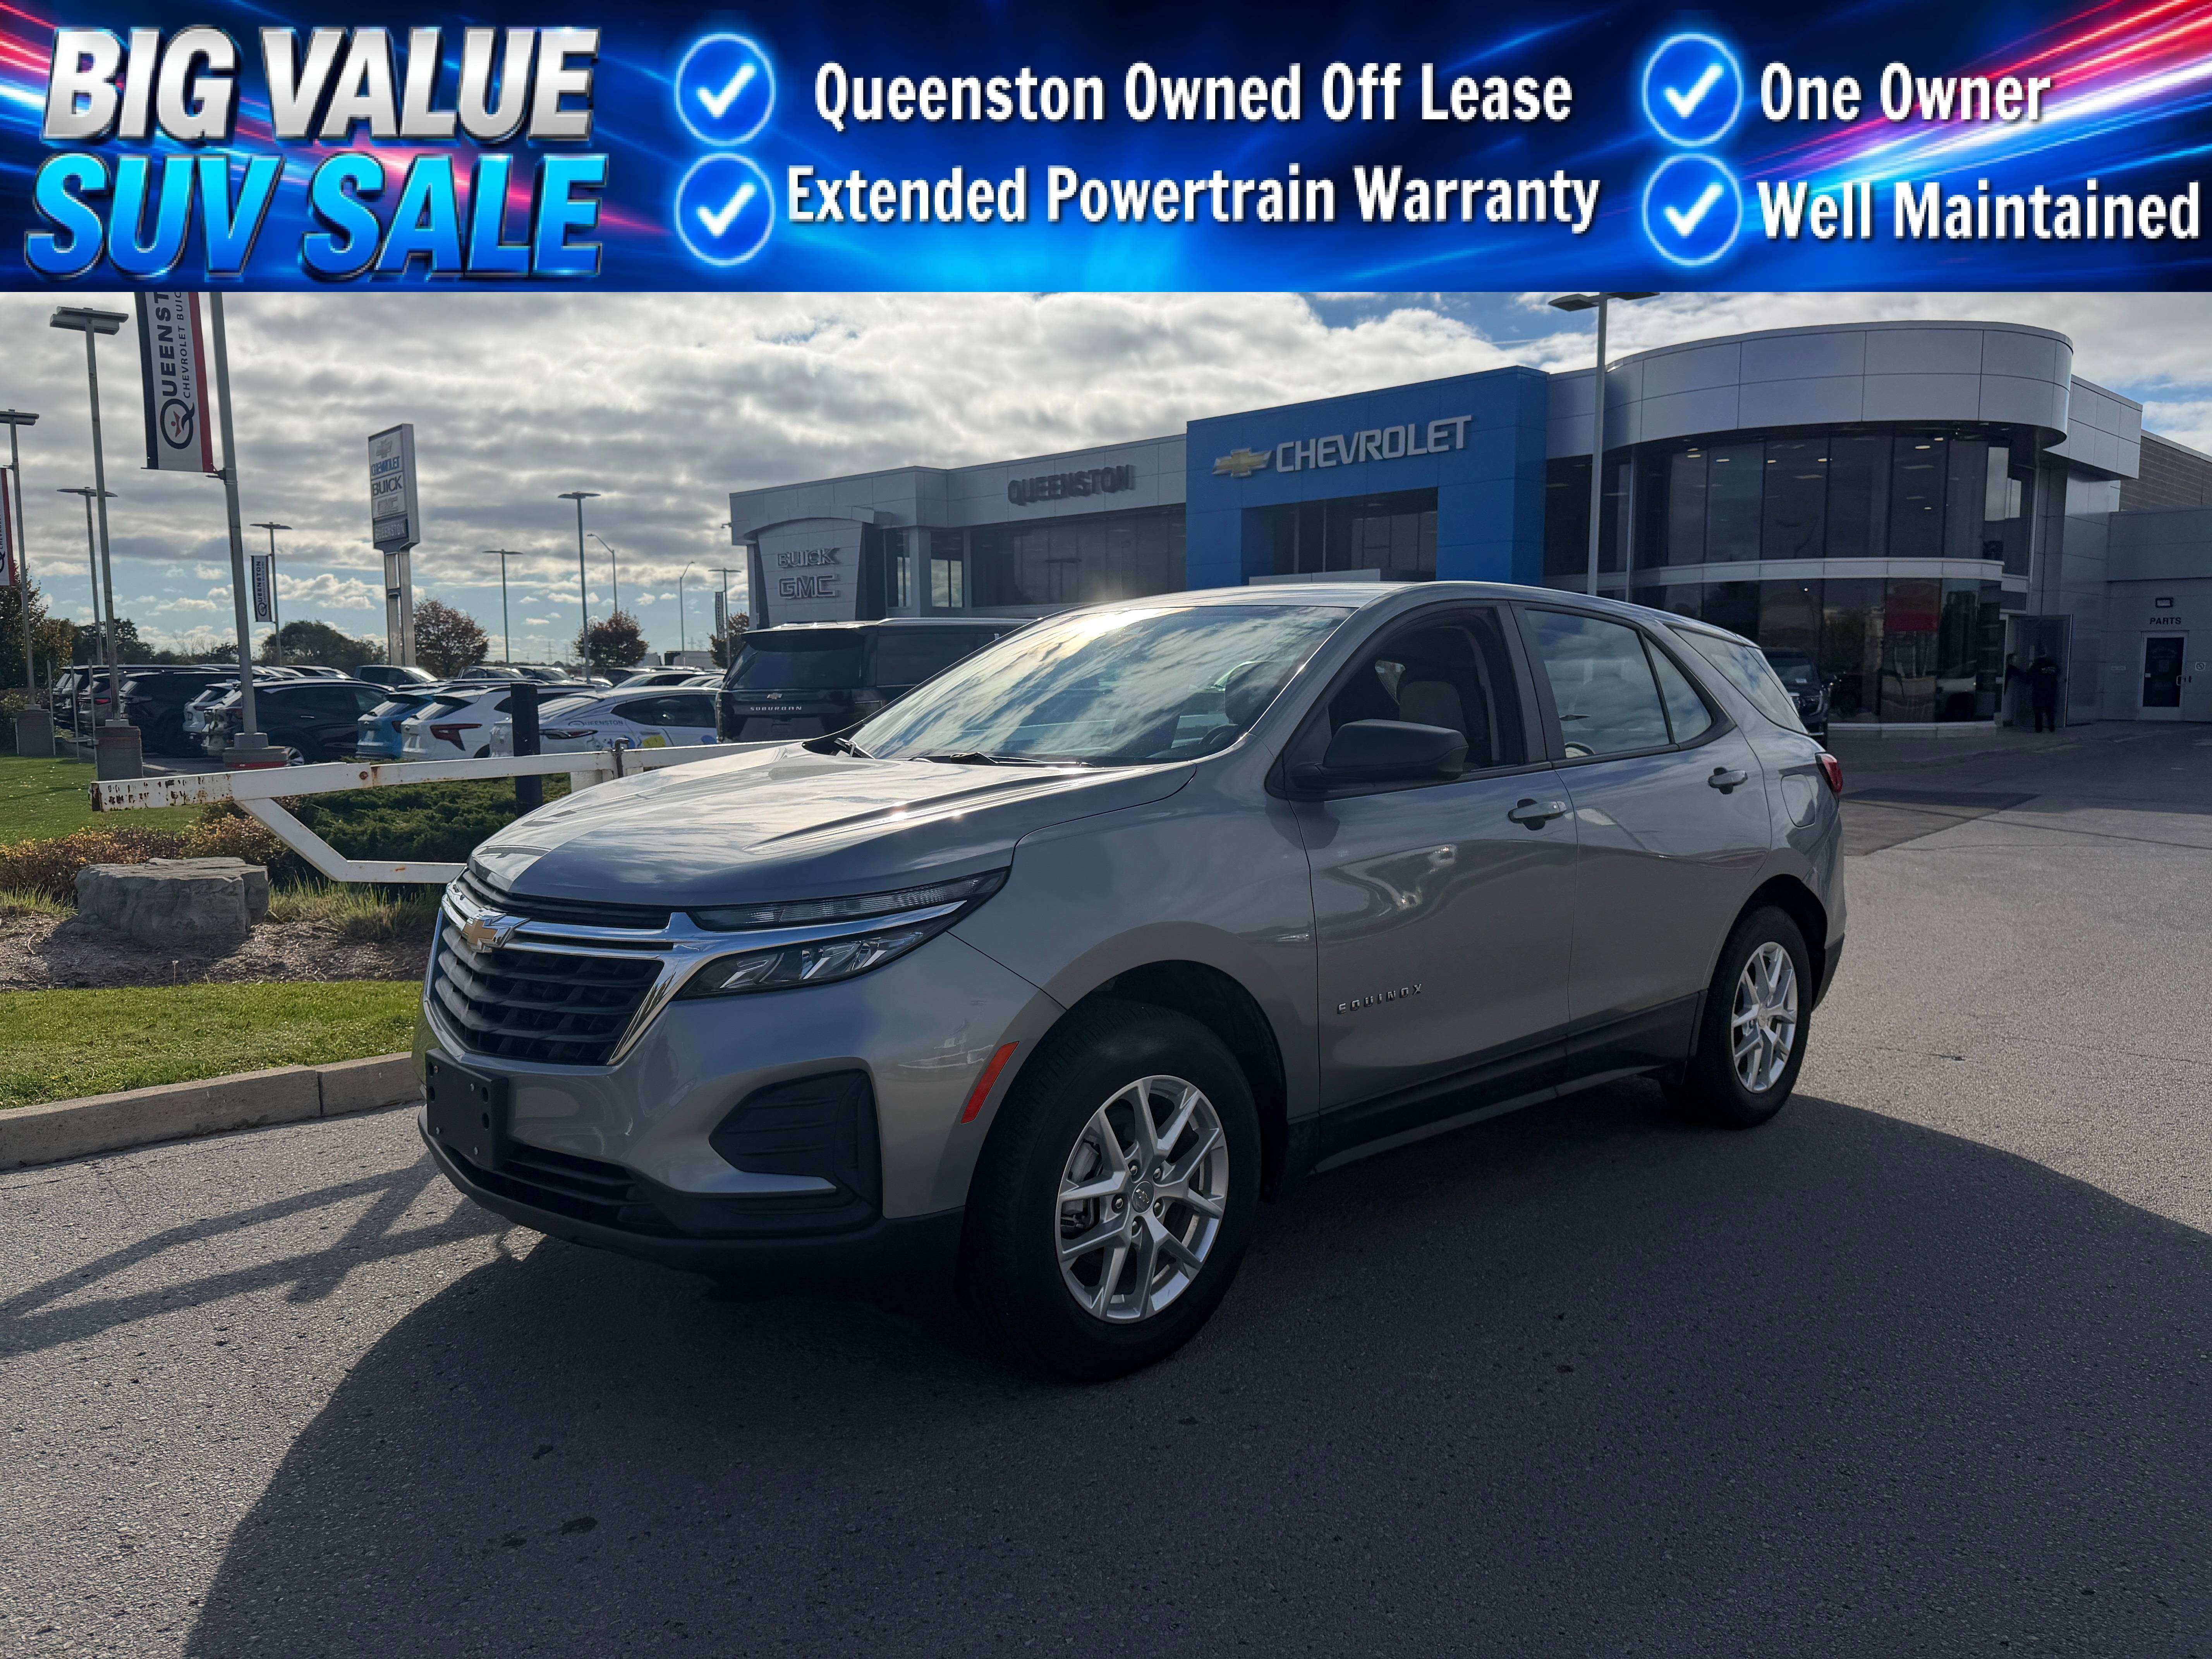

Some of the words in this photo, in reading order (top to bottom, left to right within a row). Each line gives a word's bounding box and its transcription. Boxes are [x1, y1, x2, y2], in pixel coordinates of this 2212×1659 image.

[177, 325, 191, 398] CHEVROLET
[1277, 415, 1472, 472] CHEVROLET
[373, 475, 403, 496] BUICK
[1008, 464, 1136, 506] QUEENSTON
[778, 548, 840, 568] BUICK
[256, 561, 267, 616] QUEENSTON
[779, 574, 840, 600] GMC
[2150, 617, 2181, 625] PARTS
[1337, 984, 1422, 1014] EQUINOX
